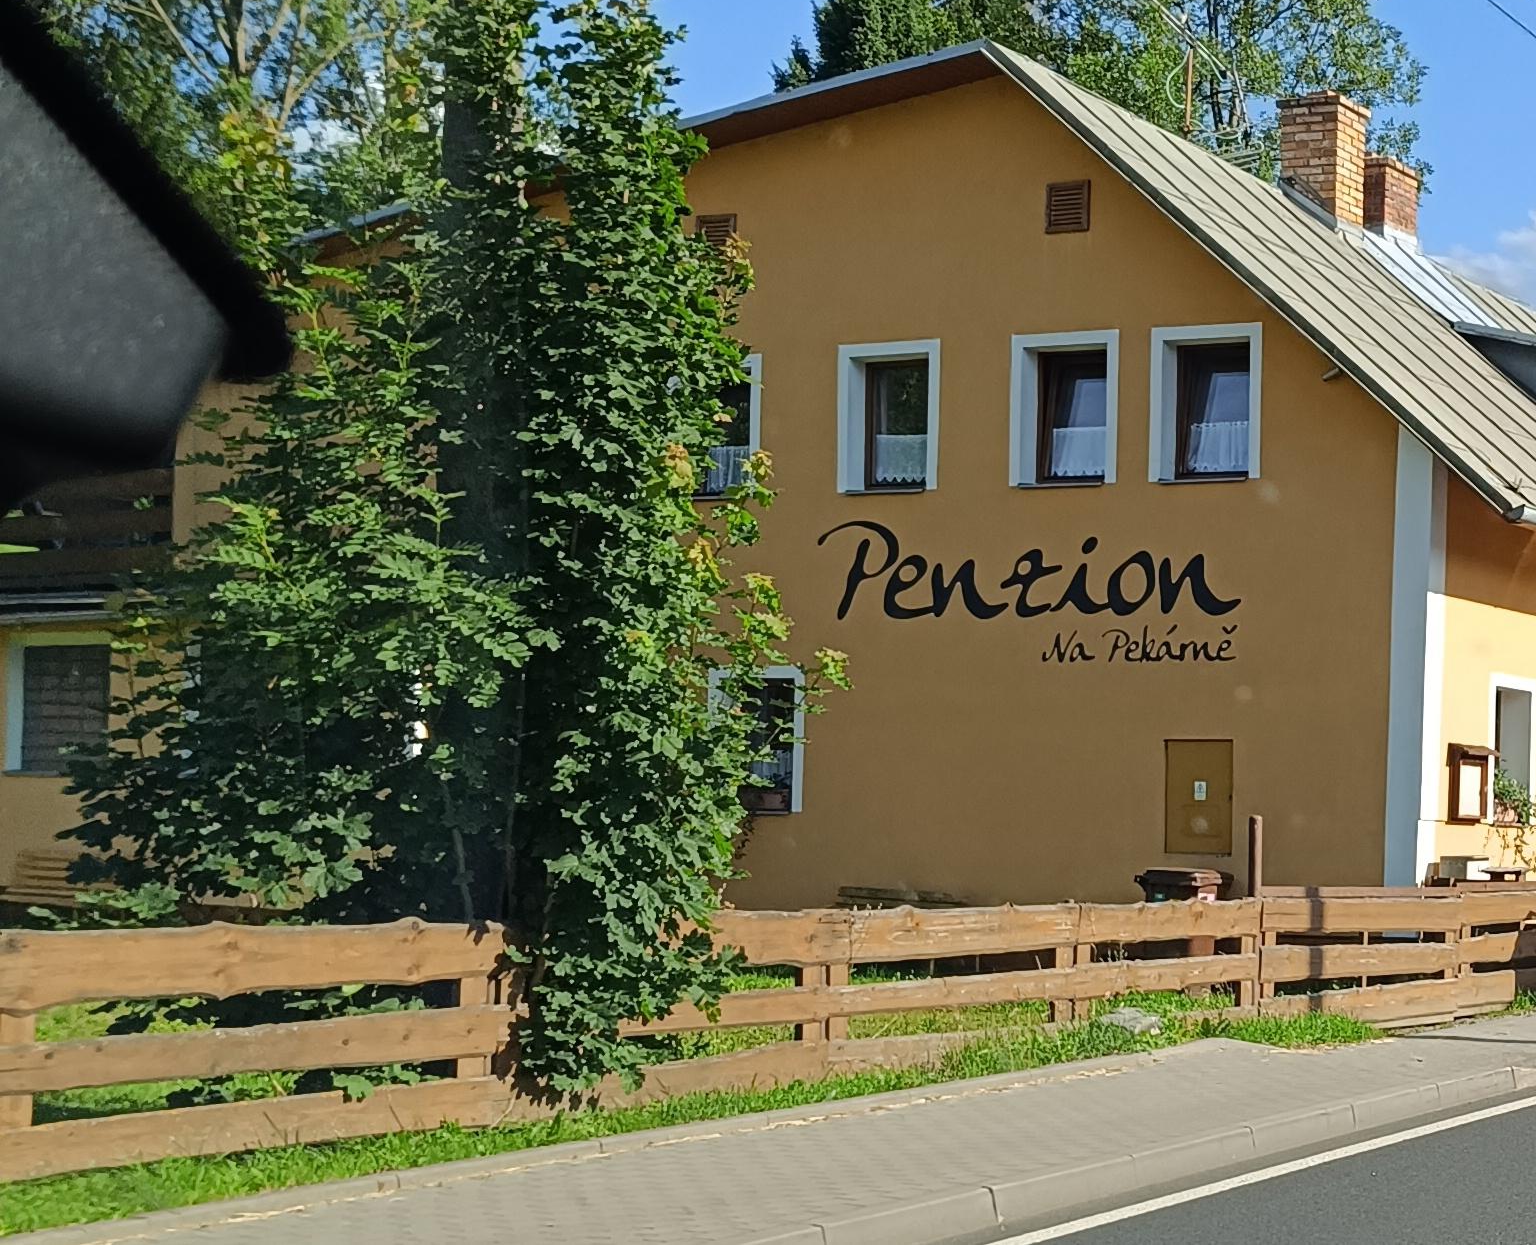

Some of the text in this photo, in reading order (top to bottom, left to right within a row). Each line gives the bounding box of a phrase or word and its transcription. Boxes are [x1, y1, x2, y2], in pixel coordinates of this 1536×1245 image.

[817, 520, 1241, 619] Penzion
[1041, 624, 1238, 663] Na Pekárně
